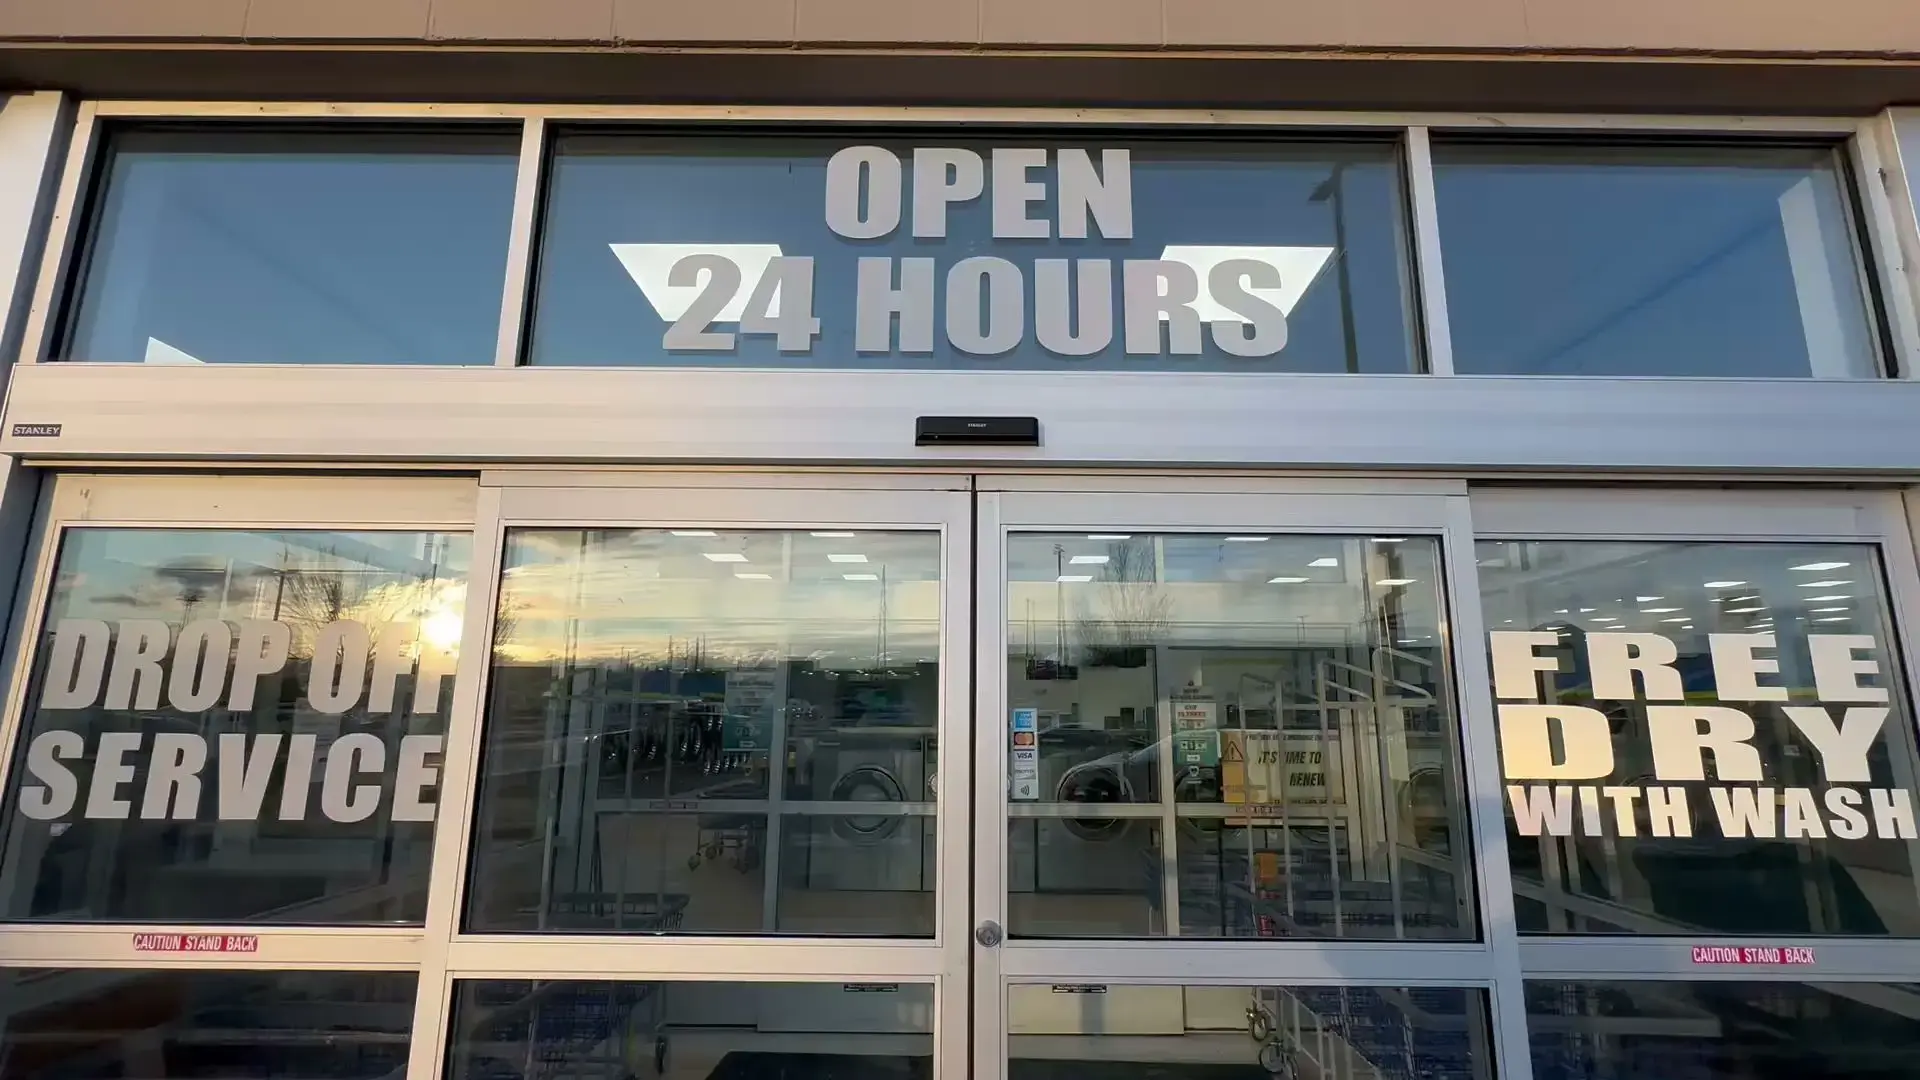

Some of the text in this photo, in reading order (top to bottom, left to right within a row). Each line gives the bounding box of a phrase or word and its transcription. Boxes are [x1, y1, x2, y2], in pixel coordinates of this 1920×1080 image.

[826, 146, 1133, 239] OPEN
[663, 253, 1288, 357] 24 HOURS
[14, 426, 60, 435] STANLEY
[40, 619, 291, 713] DROP
[1490, 631, 1890, 702] FREE
[1016, 752, 1033, 760] VISA
[1281, 751, 1307, 764] IME
[1309, 751, 1322, 764] TO
[1497, 704, 1891, 782] DRY
[19, 730, 443, 823] SERVICE
[1507, 785, 1918, 839] WITH WASH
[134, 935, 257, 951] CAUTION STAND BACK
[1693, 947, 1815, 963] CAUTION STAND BACK
